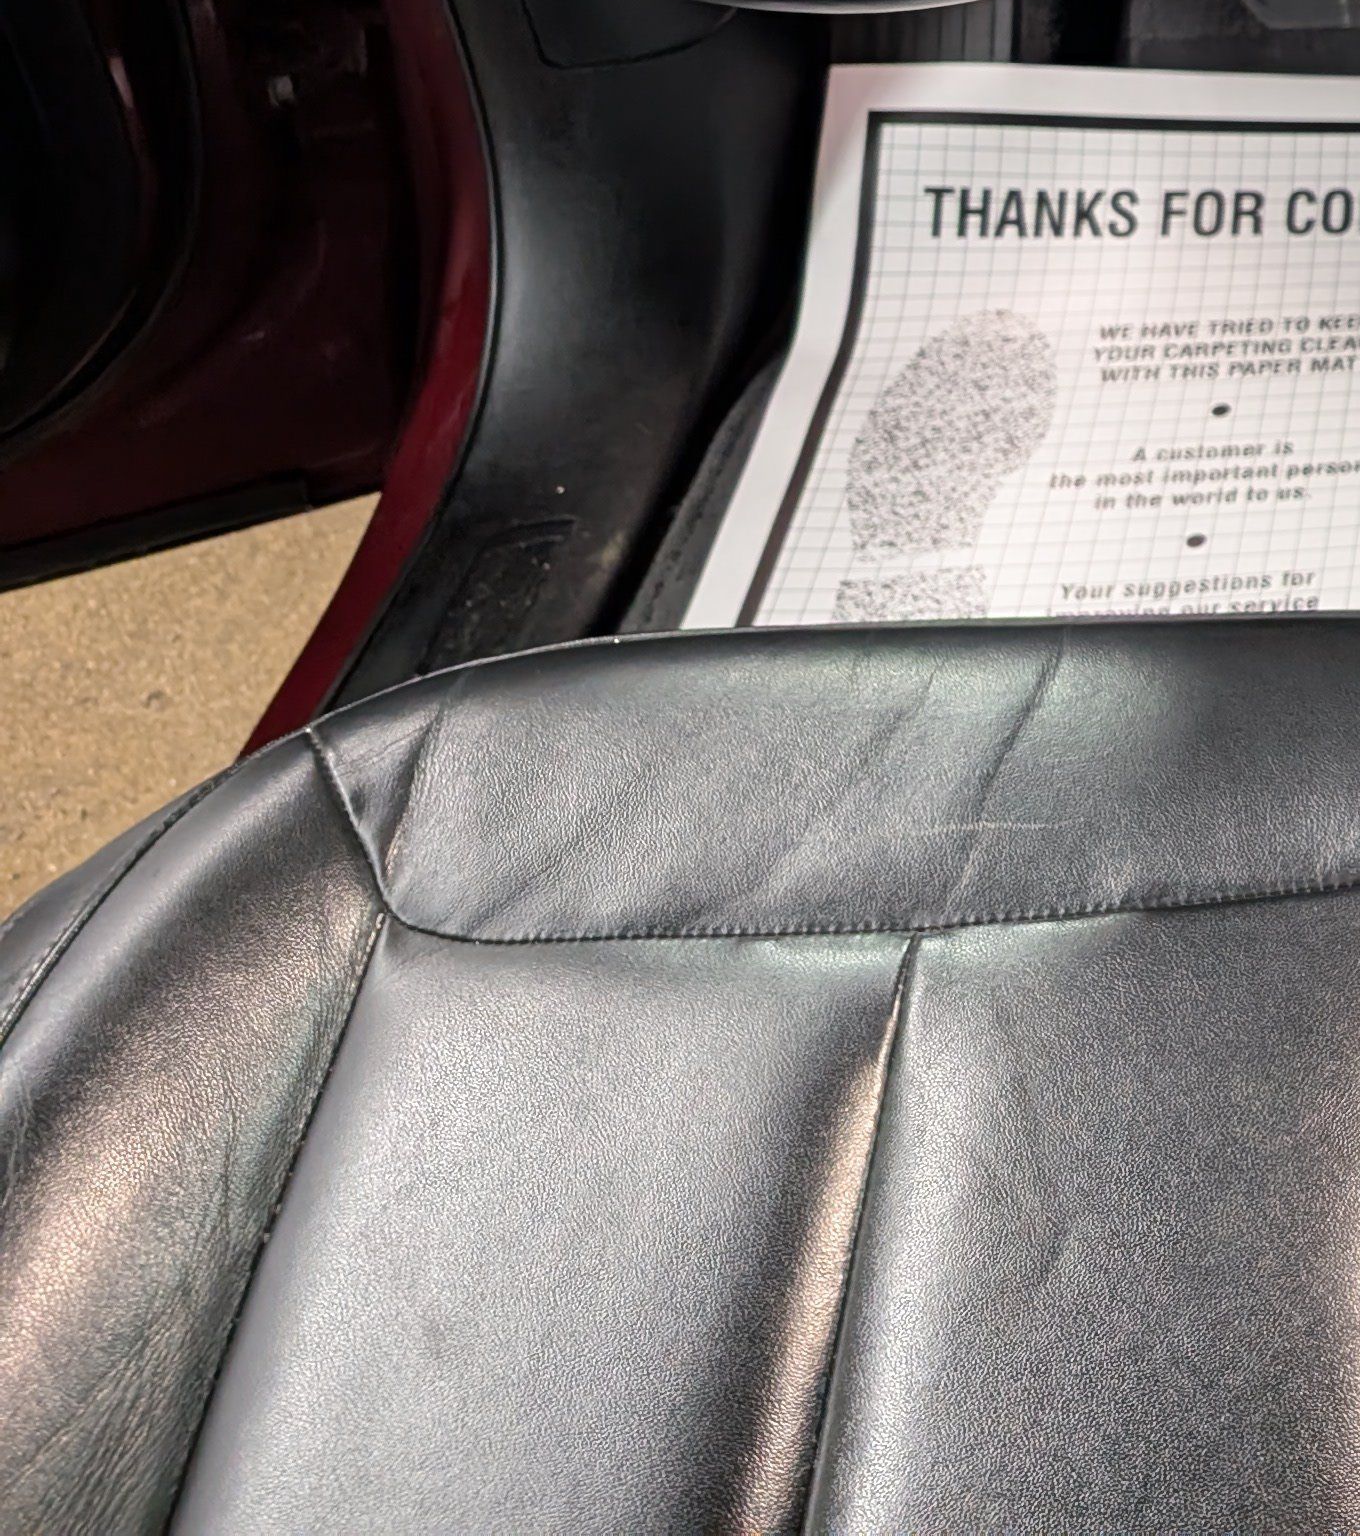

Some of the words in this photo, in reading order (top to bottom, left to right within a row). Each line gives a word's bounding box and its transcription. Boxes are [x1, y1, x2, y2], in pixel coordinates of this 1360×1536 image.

[924, 186, 1140, 239] THANKS
[1159, 189, 1264, 238] FOR
[1100, 322, 1133, 341] WE
[1140, 320, 1200, 339] HAVE
[1209, 317, 1274, 336] TRIED
[1283, 316, 1310, 333] TO
[1094, 344, 1156, 363] YOUR
[1163, 338, 1292, 360] CARPETING
[1100, 366, 1160, 383] WITH
[1169, 362, 1220, 379] THIS
[1228, 357, 1301, 377] PAPER
[1309, 354, 1358, 372] MAT
[1132, 447, 1147, 462] A
[1155, 442, 1266, 462] customer
[1273, 440, 1294, 456] is
[1049, 472, 1087, 489] the
[1096, 469, 1154, 487] most
[1161, 463, 1279, 485] important
[1094, 493, 1116, 510] in
[1125, 491, 1162, 508] the
[1170, 487, 1239, 505] world
[1246, 486, 1269, 502] to
[1060, 582, 1114, 601] Your
[1123, 572, 1273, 600] suggestions
[1281, 569, 1316, 587] for
[1231, 595, 1320, 613] service
